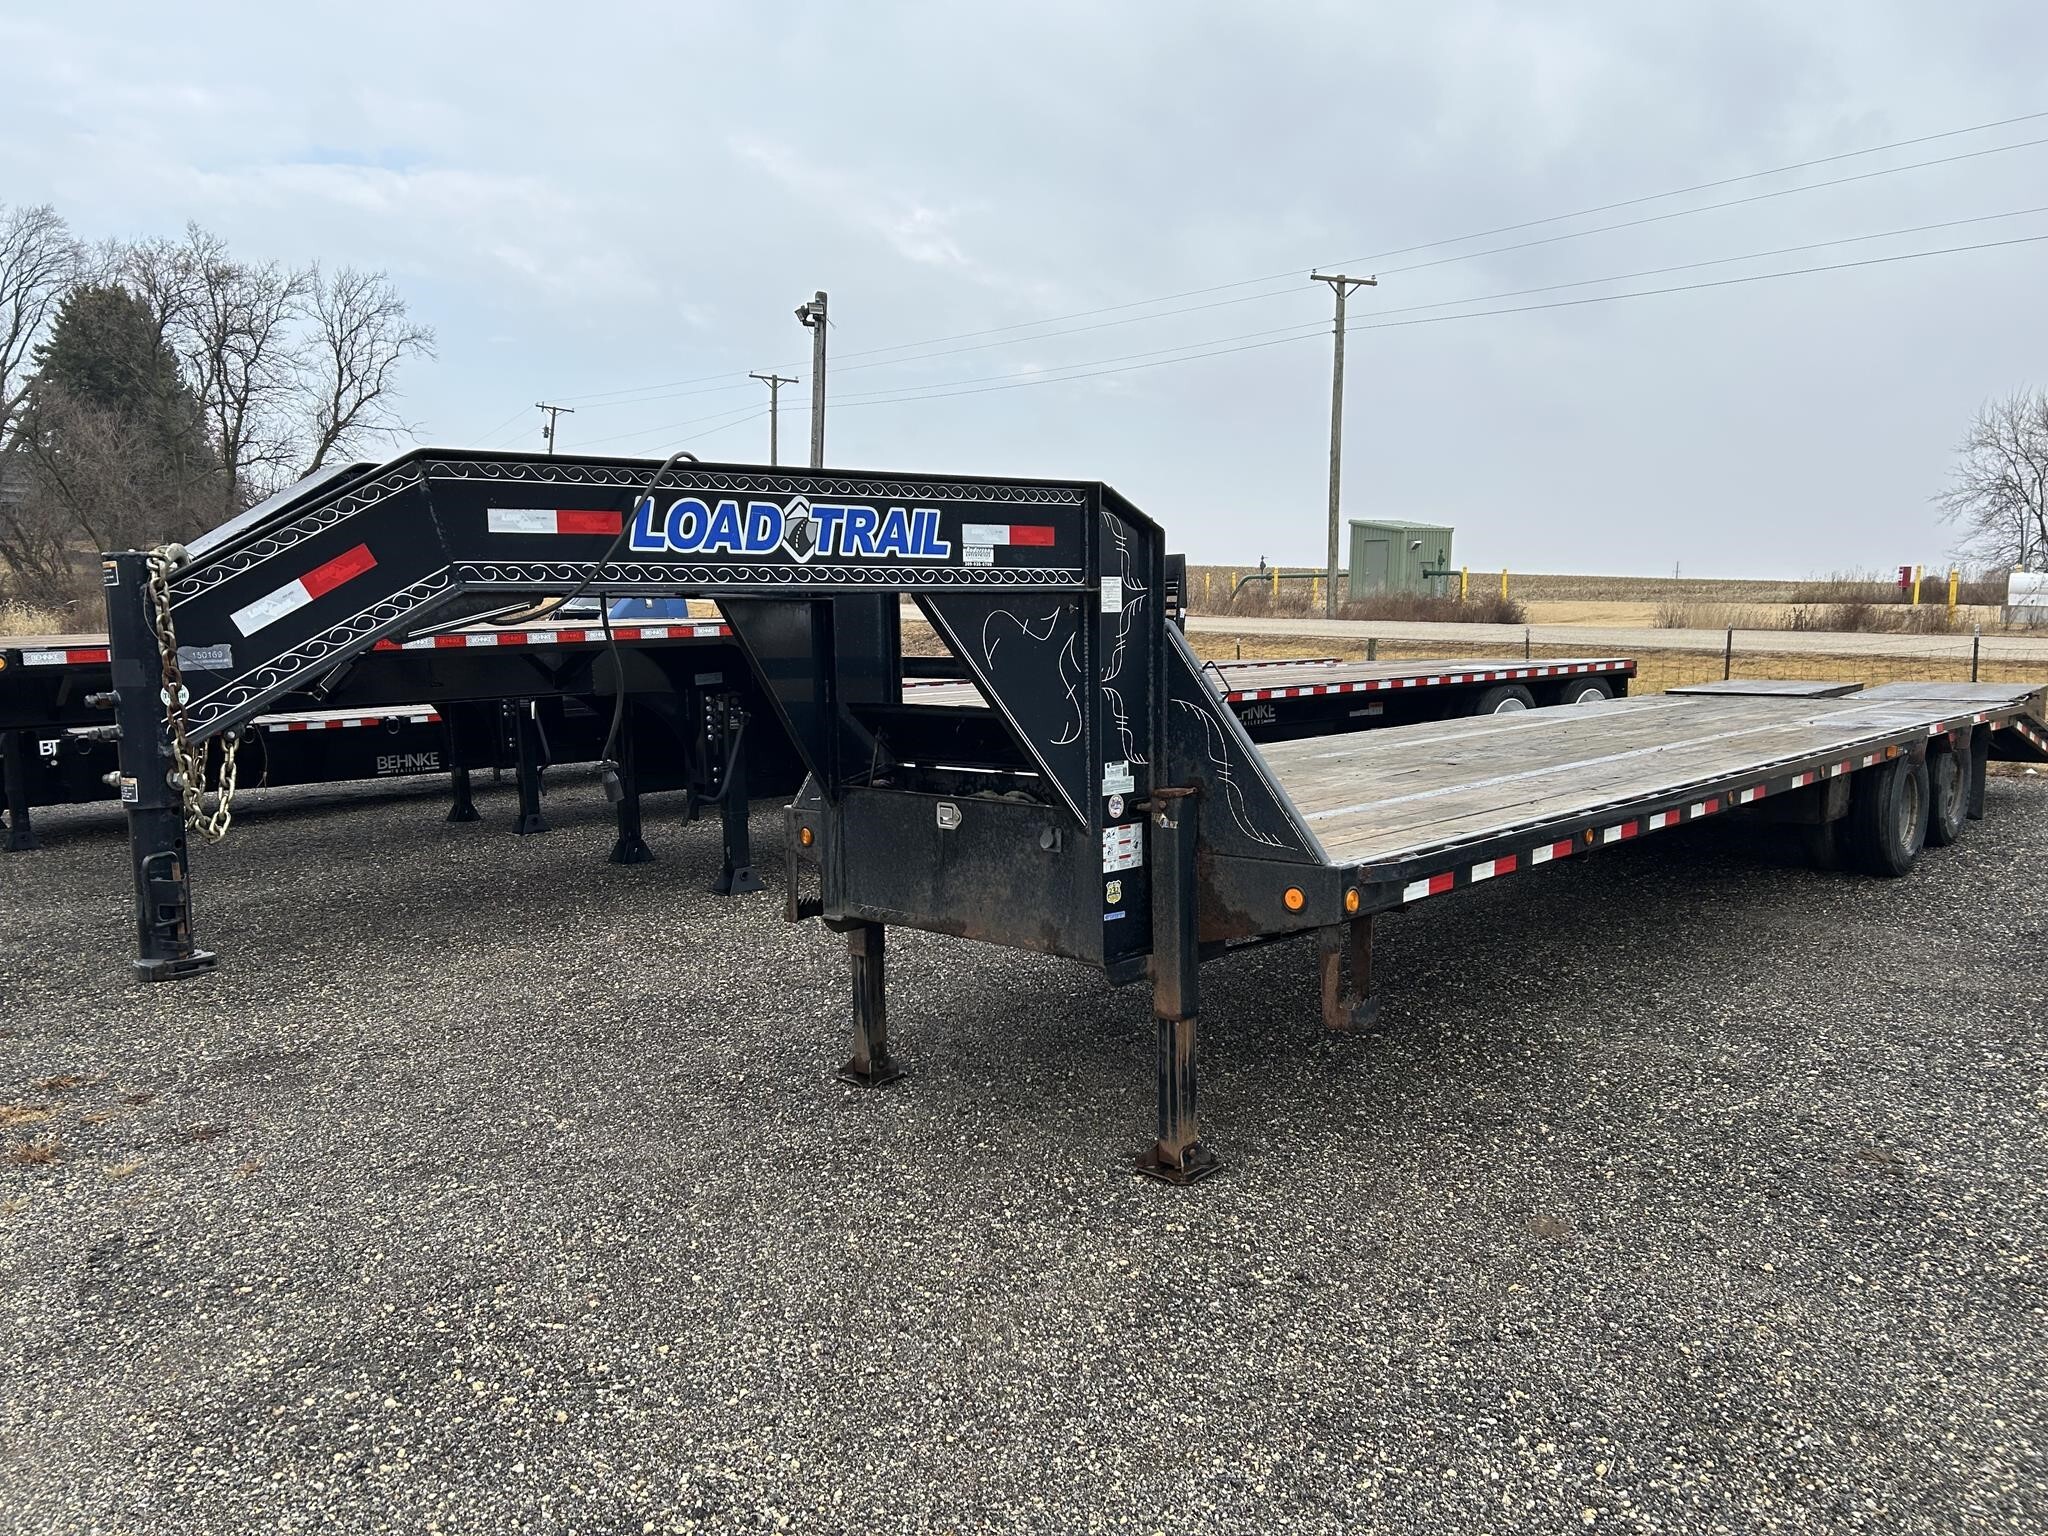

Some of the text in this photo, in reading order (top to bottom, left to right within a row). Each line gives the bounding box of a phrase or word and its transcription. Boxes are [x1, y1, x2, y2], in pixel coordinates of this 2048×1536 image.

[630, 497, 951, 559] LOAD TRAIL
[376, 752, 440, 770] BEHNKE
